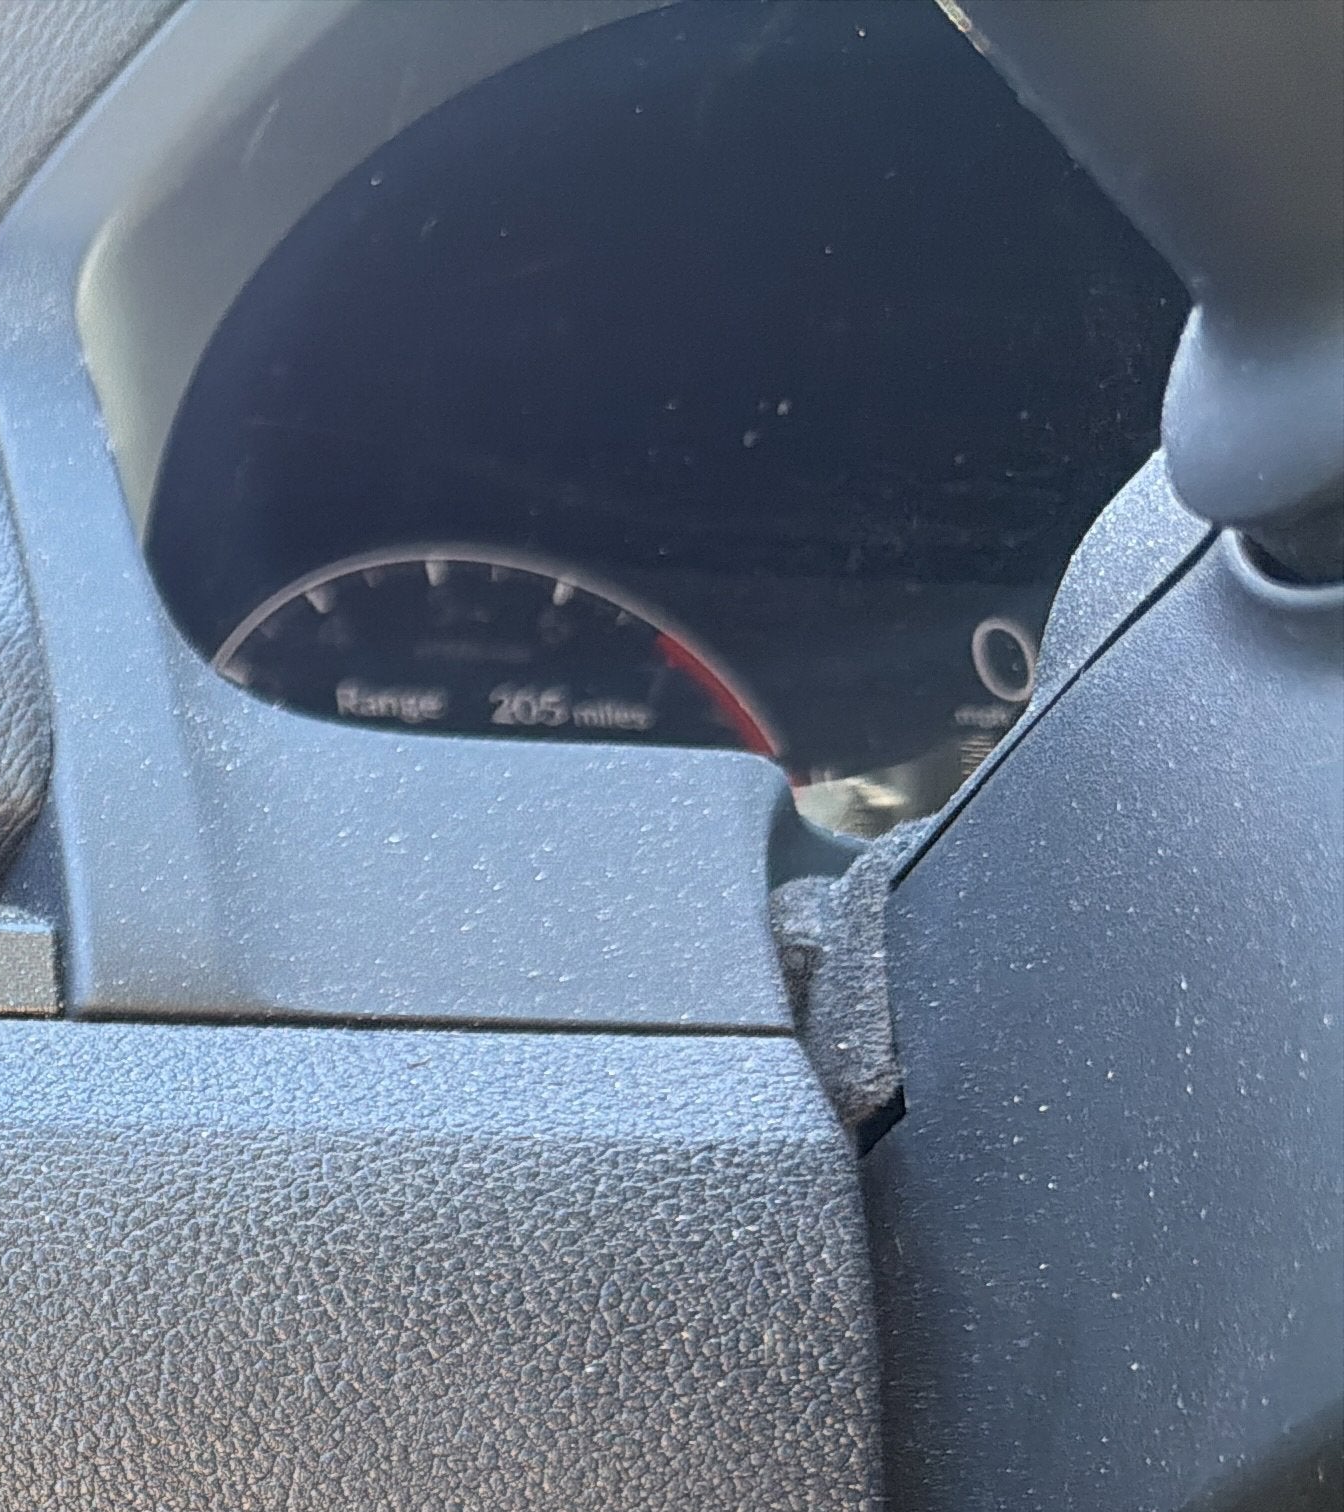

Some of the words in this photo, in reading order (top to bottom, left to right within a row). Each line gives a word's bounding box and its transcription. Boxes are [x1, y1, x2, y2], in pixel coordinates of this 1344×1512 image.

[336, 679, 444, 722] Range
[489, 684, 568, 726] 205
[572, 699, 654, 731] miles
